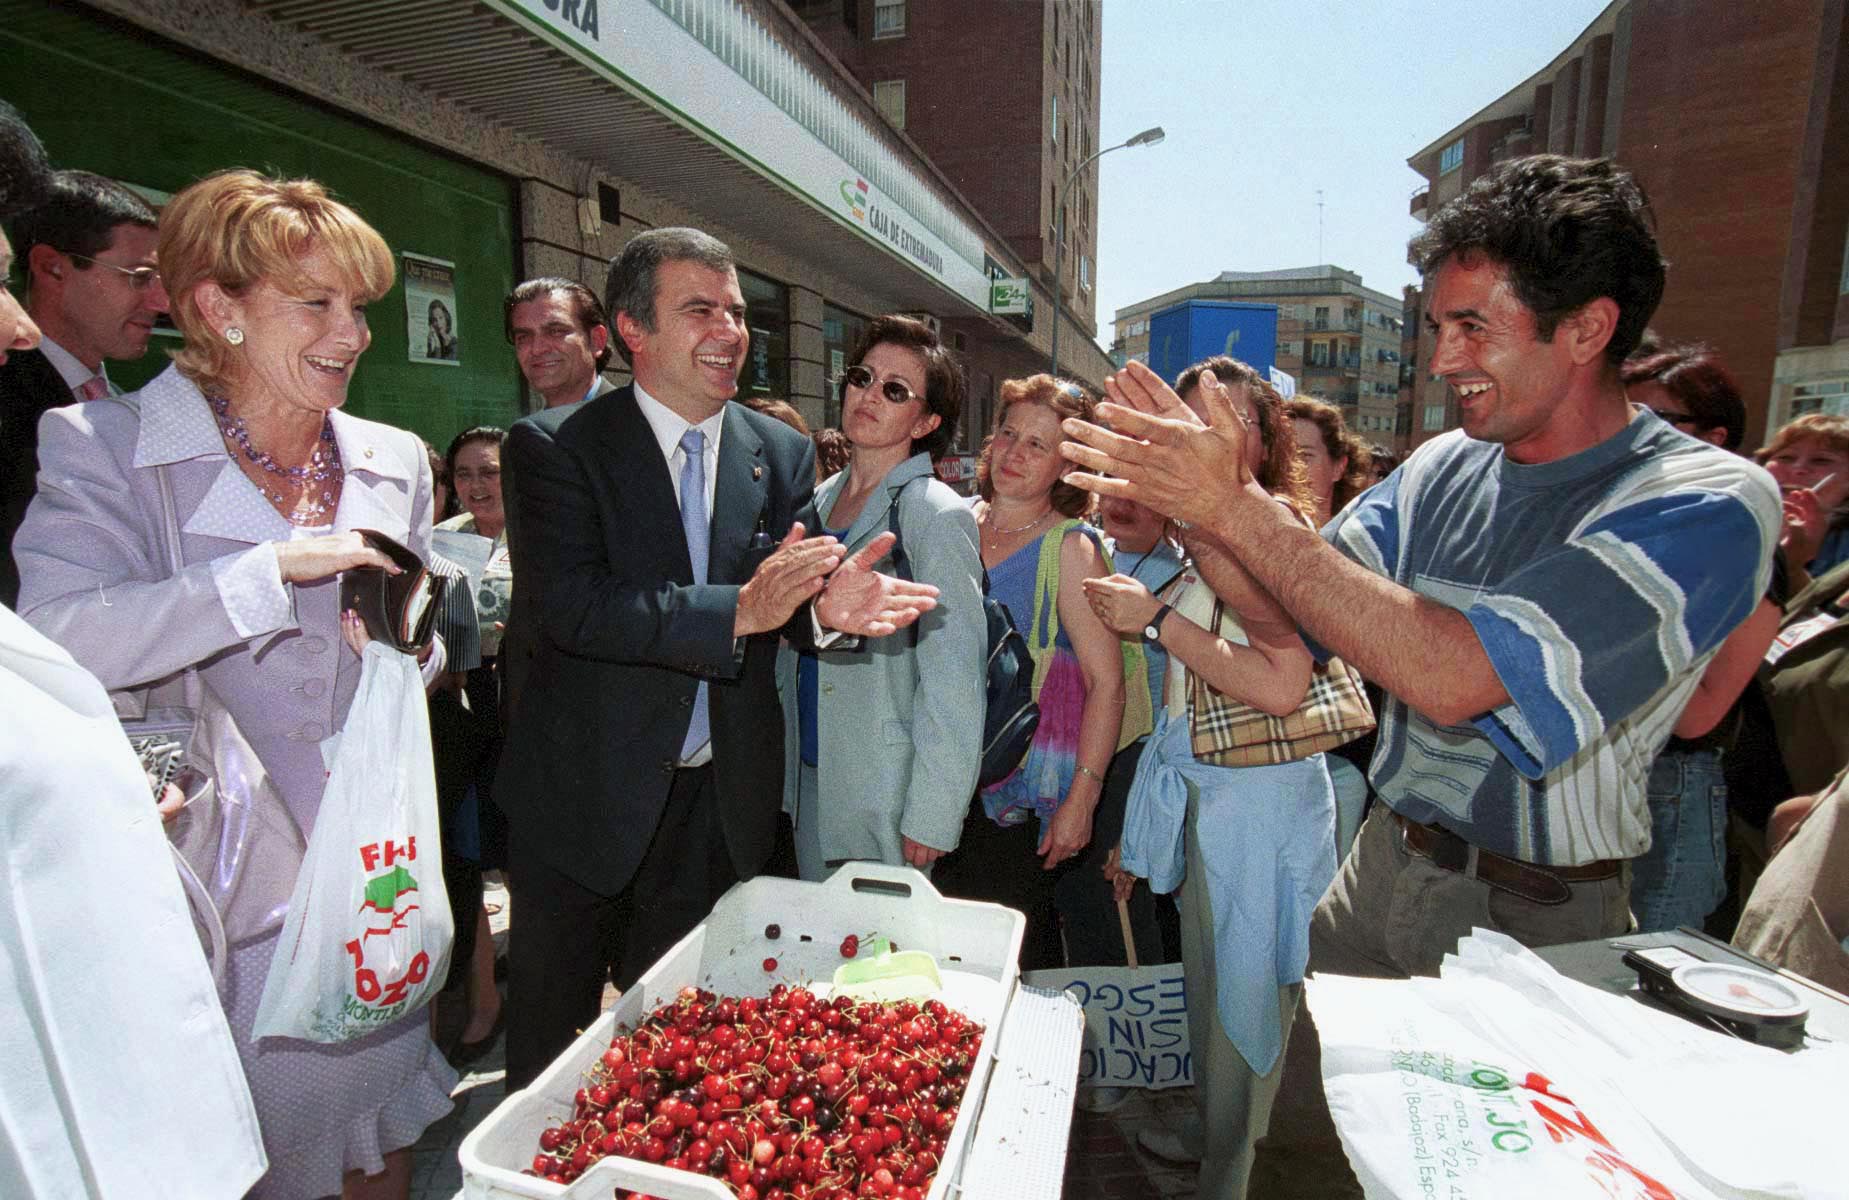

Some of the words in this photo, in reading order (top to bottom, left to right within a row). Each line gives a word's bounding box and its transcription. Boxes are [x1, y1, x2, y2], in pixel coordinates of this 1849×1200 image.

[869, 205, 889, 238] CAJA
[890, 220, 900, 247] DE
[900, 228, 943, 276] EXTREMADURA
[1108, 1016, 1183, 1050] SIN
